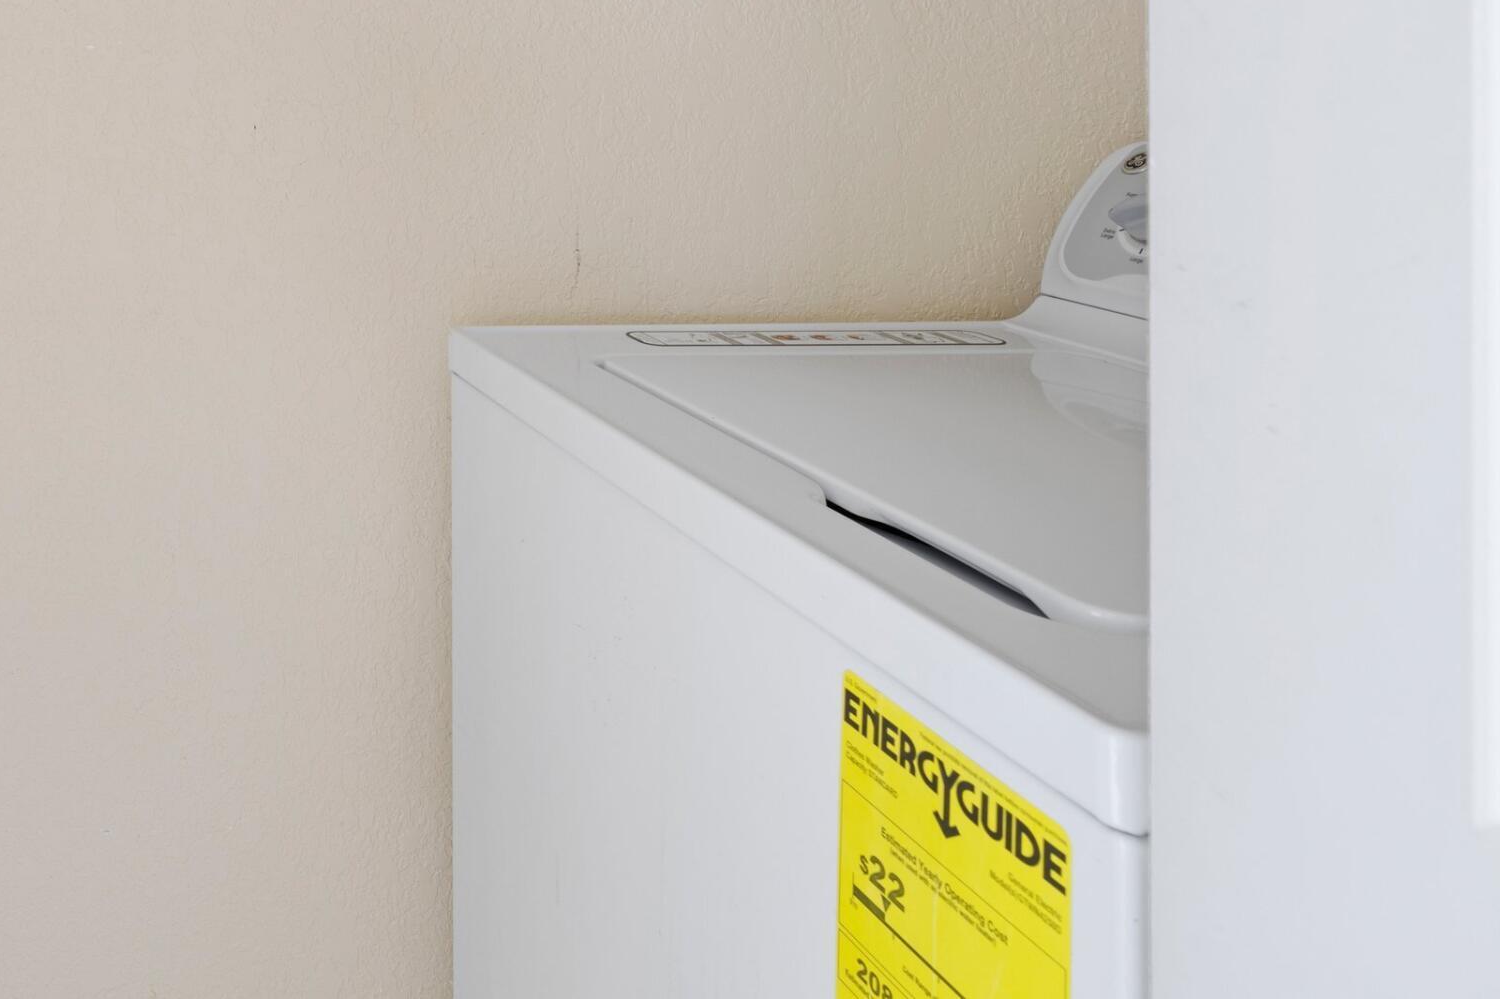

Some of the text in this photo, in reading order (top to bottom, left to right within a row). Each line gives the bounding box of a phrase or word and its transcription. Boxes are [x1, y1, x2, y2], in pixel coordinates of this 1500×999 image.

[844, 687, 1067, 896] ENERGYGUIDE
[859, 854, 905, 913] $22
[881, 826, 1009, 946] Estimated Yearly Operating Cost
